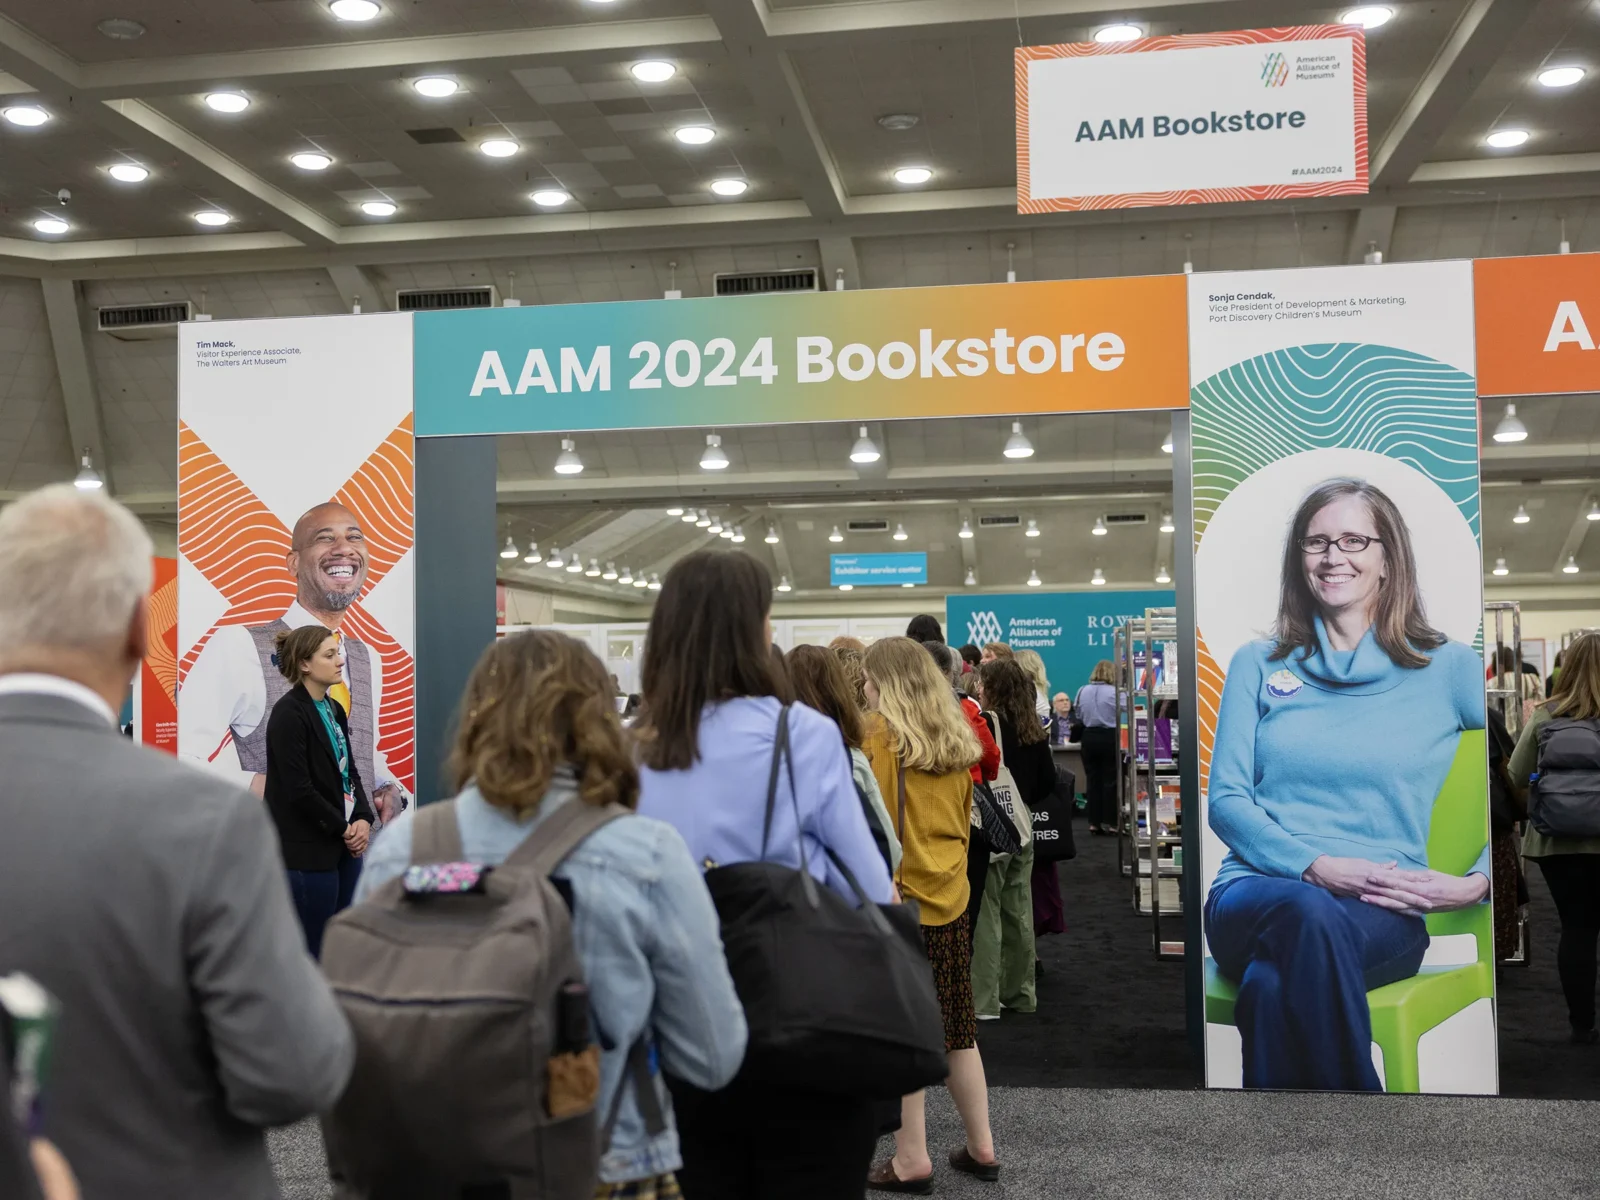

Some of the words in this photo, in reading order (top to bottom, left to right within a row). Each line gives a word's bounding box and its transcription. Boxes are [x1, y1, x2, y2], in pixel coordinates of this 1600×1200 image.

[1296, 55, 1336, 63] American
[1296, 64, 1330, 72] Alliance
[1331, 62, 1341, 70] of
[1296, 72, 1335, 80] Museums
[1075, 118, 1144, 142] AAM
[1153, 110, 1306, 138] Bookstore
[1291, 166, 1343, 176] #AAM2024
[1208, 293, 1235, 303] Sonja
[1236, 292, 1276, 301] Cendak,
[1209, 303, 1229, 312] Vice
[1230, 303, 1272, 311] President
[1274, 301, 1283, 310] of
[1286, 299, 1347, 310] Development
[1349, 298, 1357, 306] &
[1358, 296, 1407, 306] Marketing,
[1209, 314, 1227, 323] Port
[1228, 313, 1273, 322] Discovery
[1322, 308, 1362, 318] Museum
[1542, 300, 1600, 353] A
[196, 341, 211, 349] Tim
[212, 340, 236, 348] Mack,
[196, 350, 219, 358] Visitor
[220, 348, 262, 358] Experience
[263, 347, 302, 356] Associate,
[196, 360, 211, 368] The
[211, 358, 241, 367] Walters
[242, 358, 253, 366] Art
[254, 357, 287, 365] Museum
[469, 345, 611, 397] AAM
[628, 336, 778, 390] 2024
[796, 328, 1126, 384] Bookstore
[1009, 617, 1057, 627] American
[1009, 628, 1050, 637] Alliance
[1051, 626, 1063, 636] of
[1008, 638, 1056, 647] Museums
